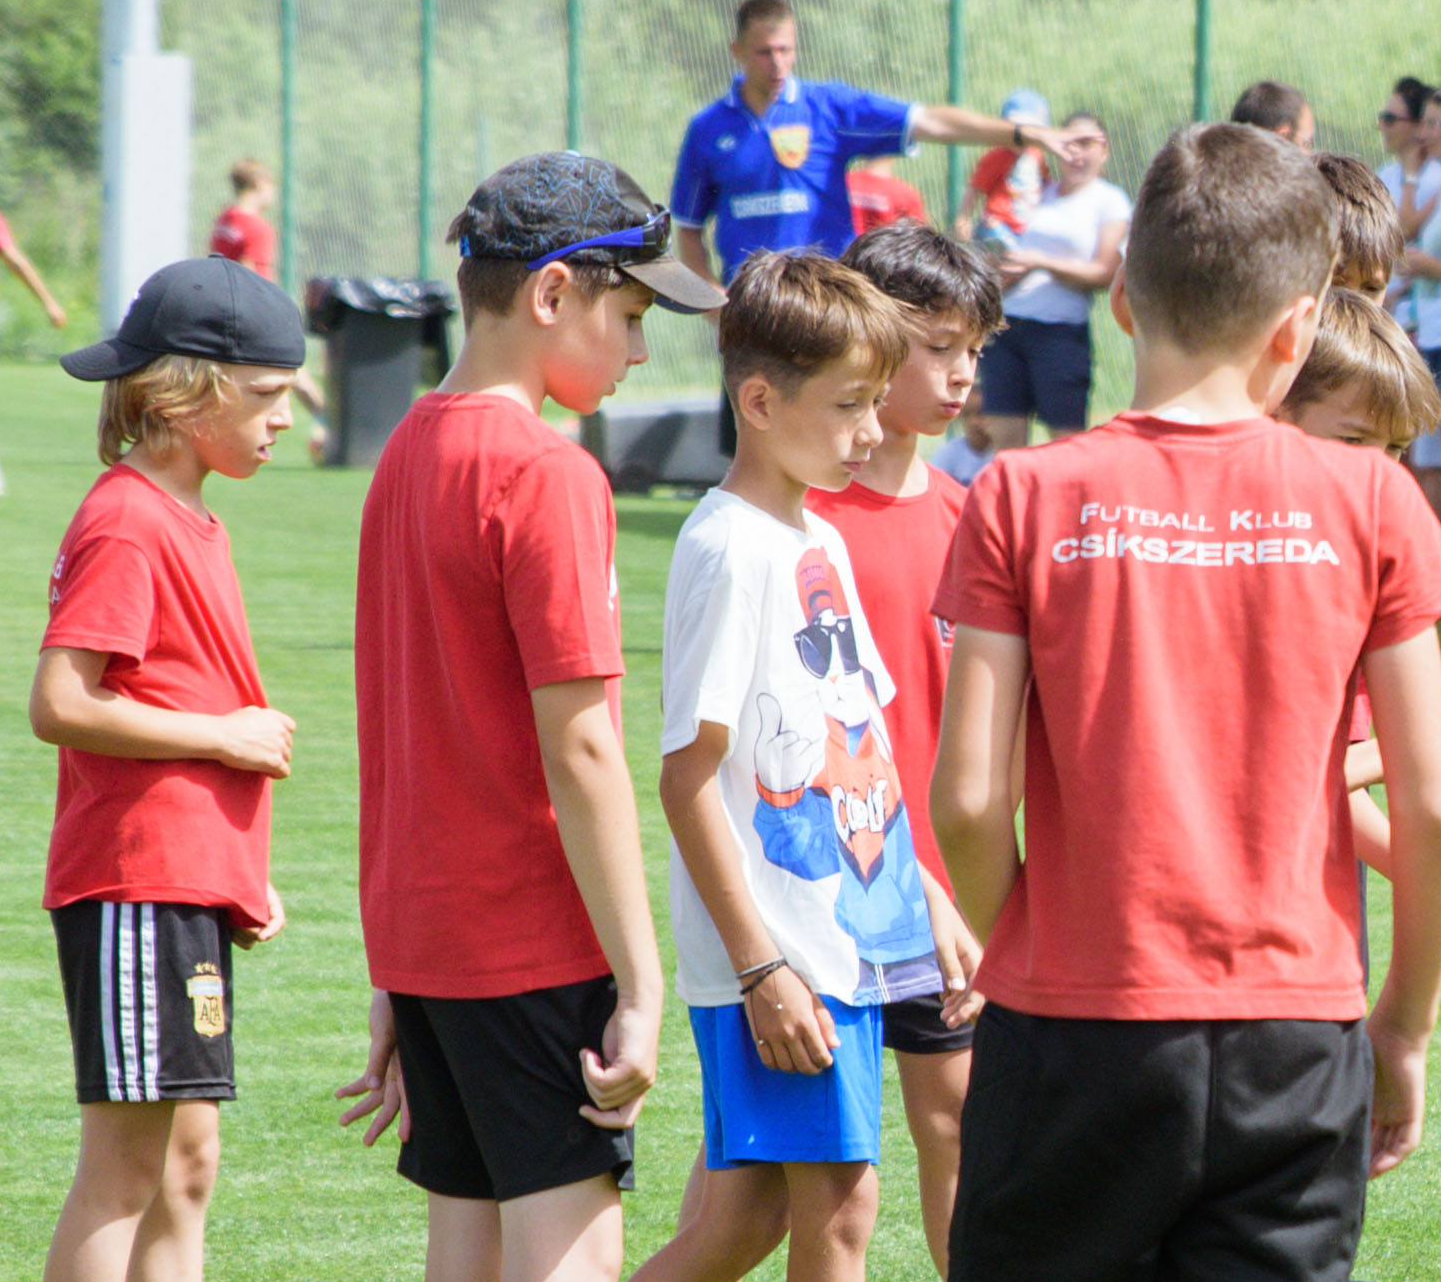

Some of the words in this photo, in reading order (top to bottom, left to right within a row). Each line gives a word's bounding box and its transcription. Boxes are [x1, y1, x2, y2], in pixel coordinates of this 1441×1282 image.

[1080, 502, 1215, 532] FUTBALL
[1230, 509, 1313, 532] KLUB
[1052, 527, 1340, 566] CSÍKSZEREDA
